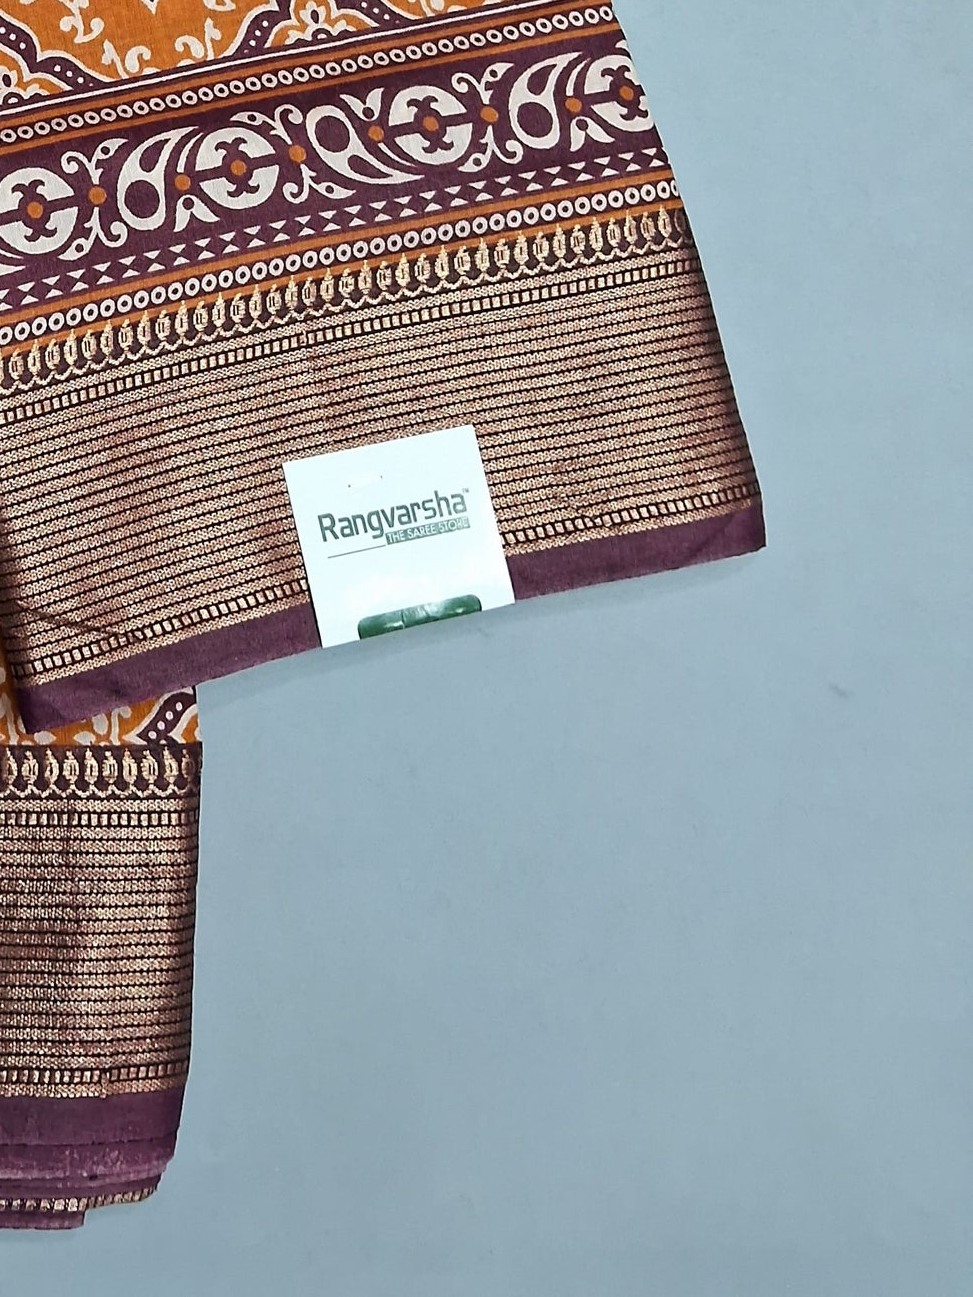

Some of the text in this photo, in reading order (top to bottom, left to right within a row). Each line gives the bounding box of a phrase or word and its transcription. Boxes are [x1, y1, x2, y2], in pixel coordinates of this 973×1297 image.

[317, 490, 467, 542] Rangvarsha
[387, 517, 469, 544] THE SAREE STORE
